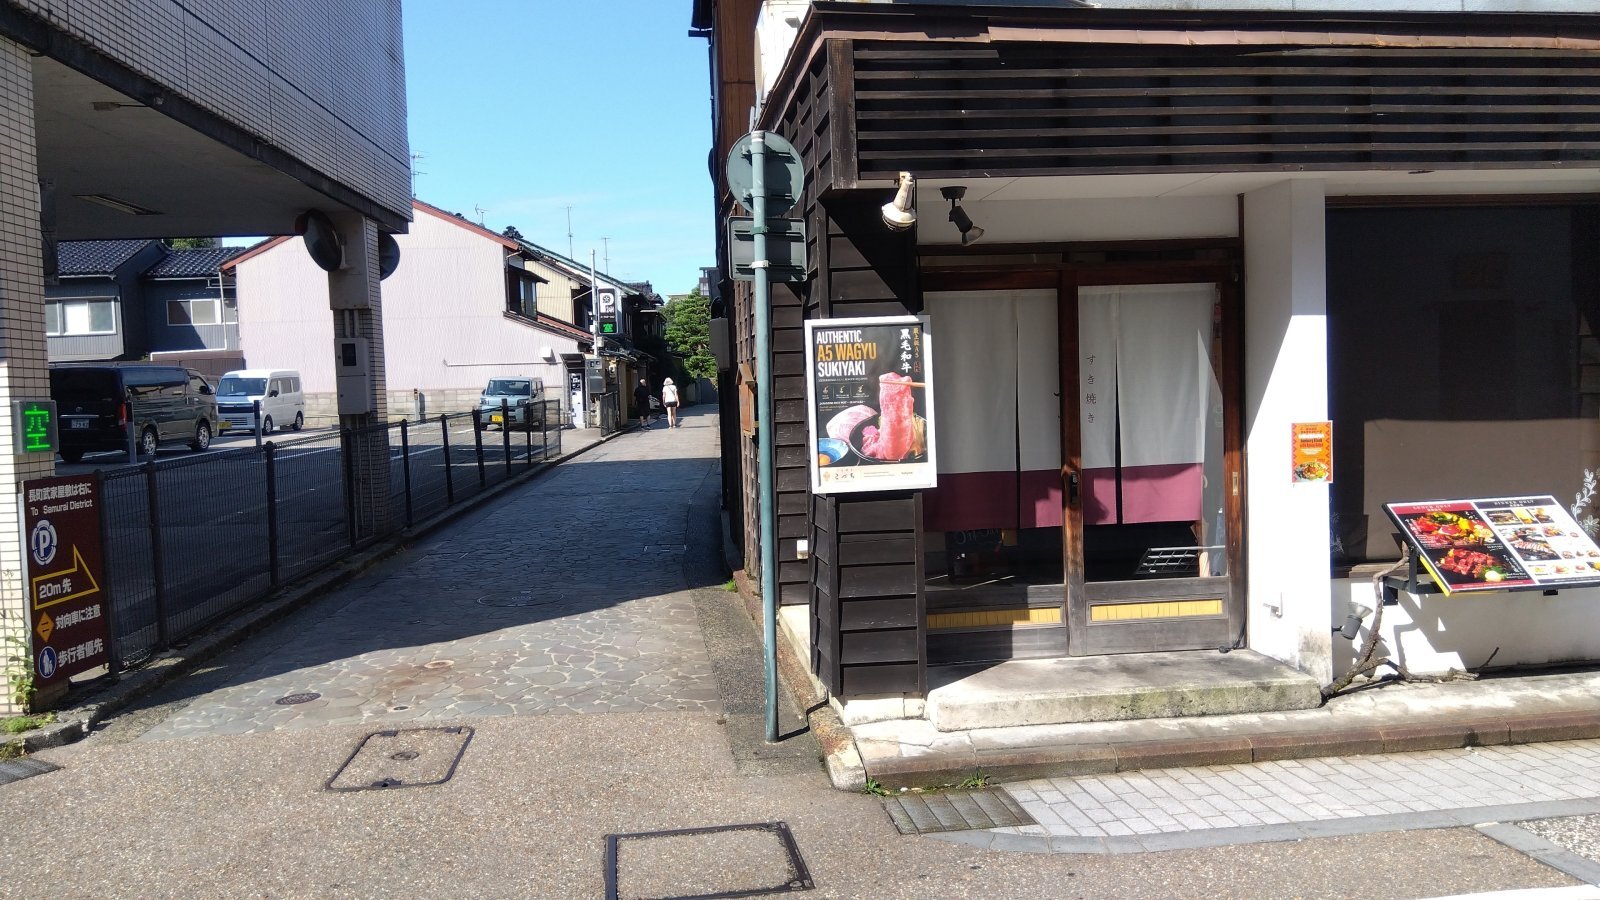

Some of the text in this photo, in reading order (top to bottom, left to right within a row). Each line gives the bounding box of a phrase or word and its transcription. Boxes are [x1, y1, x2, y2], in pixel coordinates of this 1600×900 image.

[817, 331, 862, 344] AUTHENTIC
[900, 328, 912, 373] 黒毛和牛
[818, 343, 877, 361] A5 WAGYU
[818, 361, 865, 378] SUKIYAKI
[1085, 354, 1097, 424] すき焼き
[24, 405, 51, 449] 空
[29, 483, 92, 502] 長町武家屋敷は右に
[30, 499, 93, 517] To Samurai District
[39, 530, 51, 558] P
[55, 604, 102, 630] 対向車に注意
[58, 638, 104, 668] 歩行者優先
